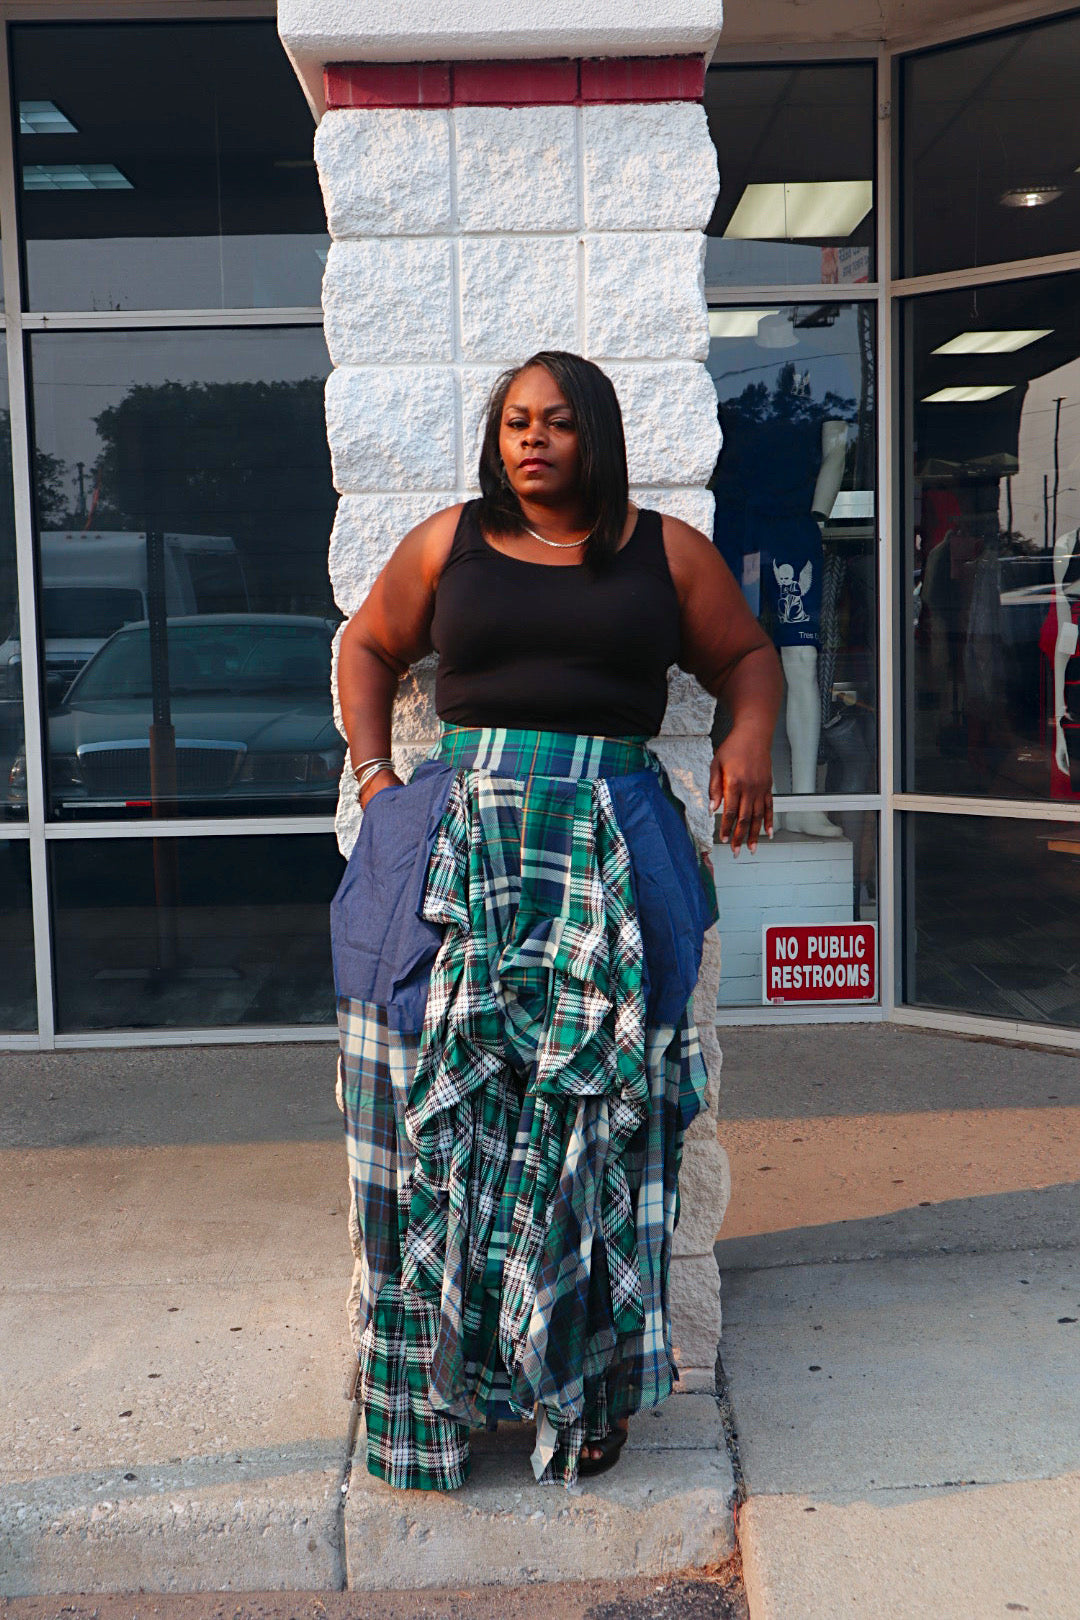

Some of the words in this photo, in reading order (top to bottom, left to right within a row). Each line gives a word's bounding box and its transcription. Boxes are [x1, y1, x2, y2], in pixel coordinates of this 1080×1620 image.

[775, 936, 799, 959] NO
[807, 935, 865, 958] PUBLIC
[771, 964, 869, 988] RESTROOMS
